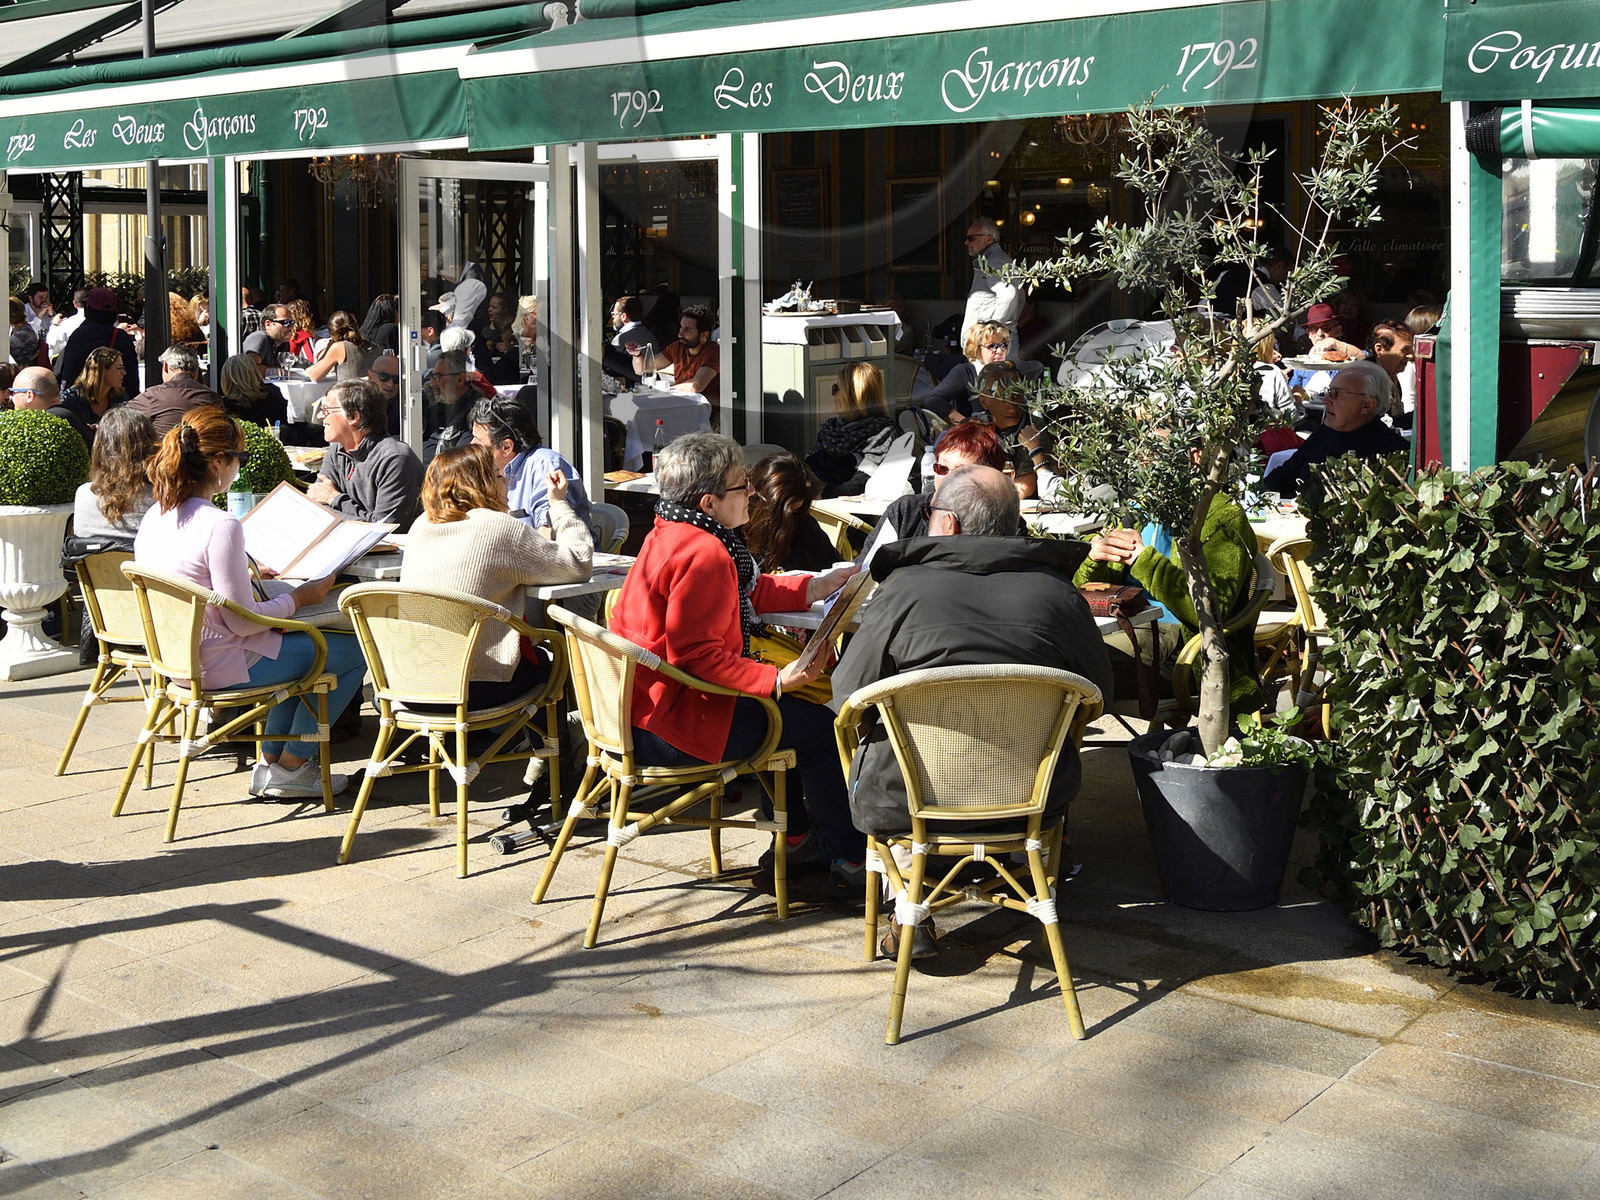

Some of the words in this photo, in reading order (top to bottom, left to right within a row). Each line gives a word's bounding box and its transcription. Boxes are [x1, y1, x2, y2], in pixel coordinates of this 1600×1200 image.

[610, 89, 664, 129] 1792
[713, 67, 774, 109] Les
[803, 59, 906, 105] Deux
[941, 46, 1096, 113] Garçons
[1175, 37, 1259, 92] 1792
[1467, 30, 1600, 84] Coqui
[7, 133, 36, 162] 1792
[63, 118, 96, 149] Les
[112, 114, 165, 146] Deux
[182, 107, 257, 151] Garçons
[292, 107, 329, 141] 1792
